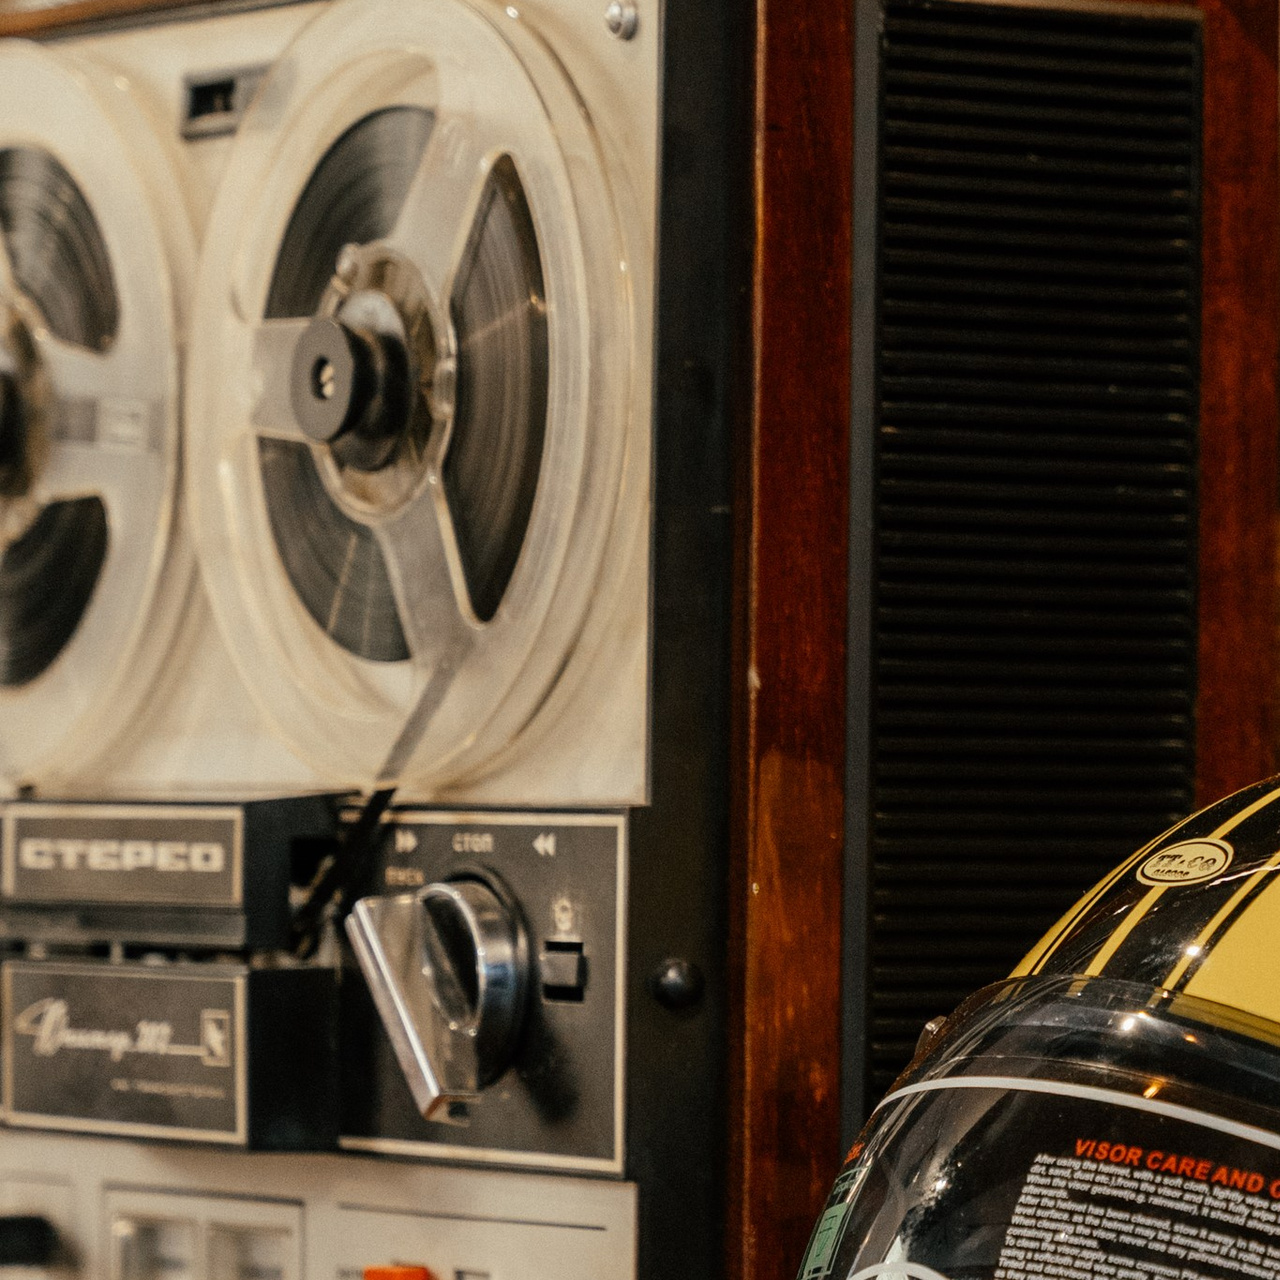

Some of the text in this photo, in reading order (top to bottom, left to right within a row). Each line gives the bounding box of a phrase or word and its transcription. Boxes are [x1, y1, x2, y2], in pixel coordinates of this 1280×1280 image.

[1026, 1174, 1051, 1184] When
[1052, 1178, 1066, 1187] the
[1068, 1181, 1090, 1191] visor
[1057, 1159, 1082, 1170] using
[1083, 1161, 1097, 1170] the
[1133, 1171, 1154, 1180] with
[1163, 1177, 1183, 1187] soft
[1246, 1196, 1269, 1208] wipe
[1075, 1139, 1142, 1166] VISOR
[1146, 1151, 1212, 1181] CARE
[1210, 1166, 1265, 1194] AND
[1041, 1198, 1055, 1207] the
[1088, 1204, 1105, 1215] has
[1106, 1208, 1130, 1220] been
[1140, 1183, 1156, 1192] the
[1158, 1187, 1182, 1198] visor
[1184, 1193, 1203, 1203] and
[1204, 1197, 1226, 1208] then
[1252, 1210, 1276, 1221] wipe
